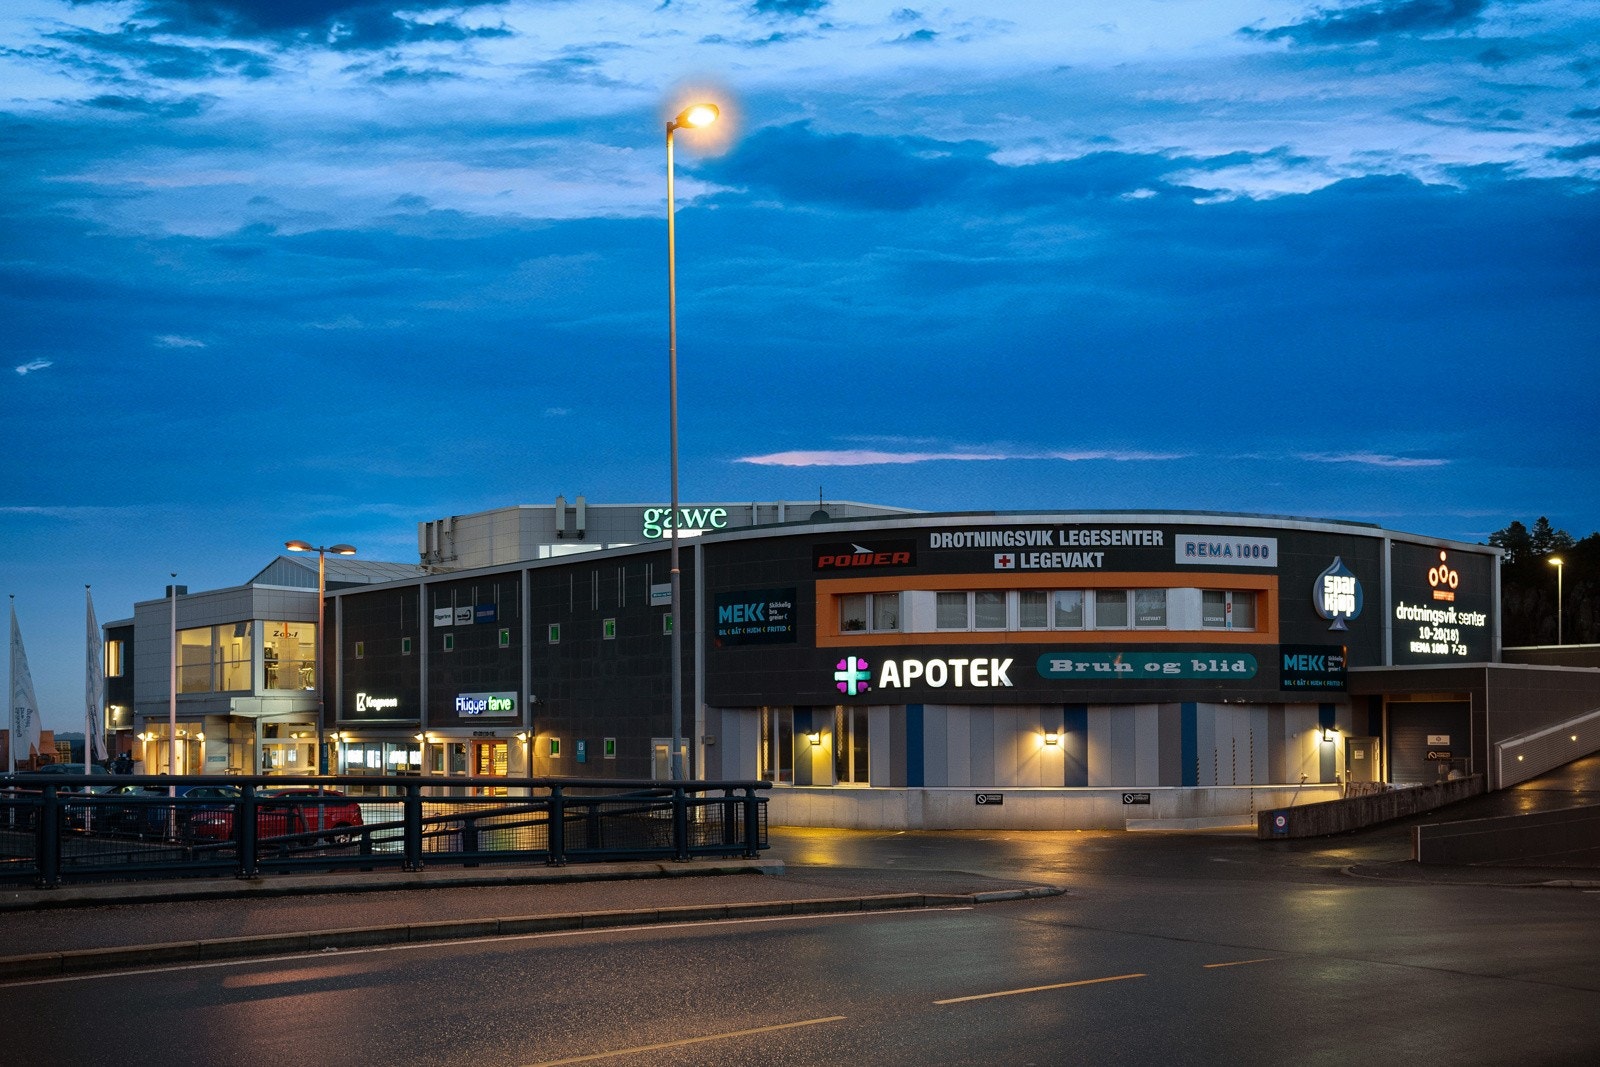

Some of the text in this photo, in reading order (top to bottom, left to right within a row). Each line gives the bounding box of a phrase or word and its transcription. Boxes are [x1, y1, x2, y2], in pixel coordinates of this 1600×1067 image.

[643, 507, 727, 538] gawe
[930, 529, 1164, 549] DROTNINGSVIK LEGESENTER
[1185, 541, 1269, 559] REMA 1000
[817, 551, 911, 568] POWER
[1020, 552, 1105, 569] LEGEVAKT
[1396, 601, 1486, 627] drotningsvik senter
[1419, 626, 1459, 644] 10-20(18)
[1451, 644, 1467, 656] 7-23
[878, 658, 1014, 689] APOTEK
[1049, 658, 1247, 674] Brun og blid
[455, 695, 513, 714] Flügger farve
